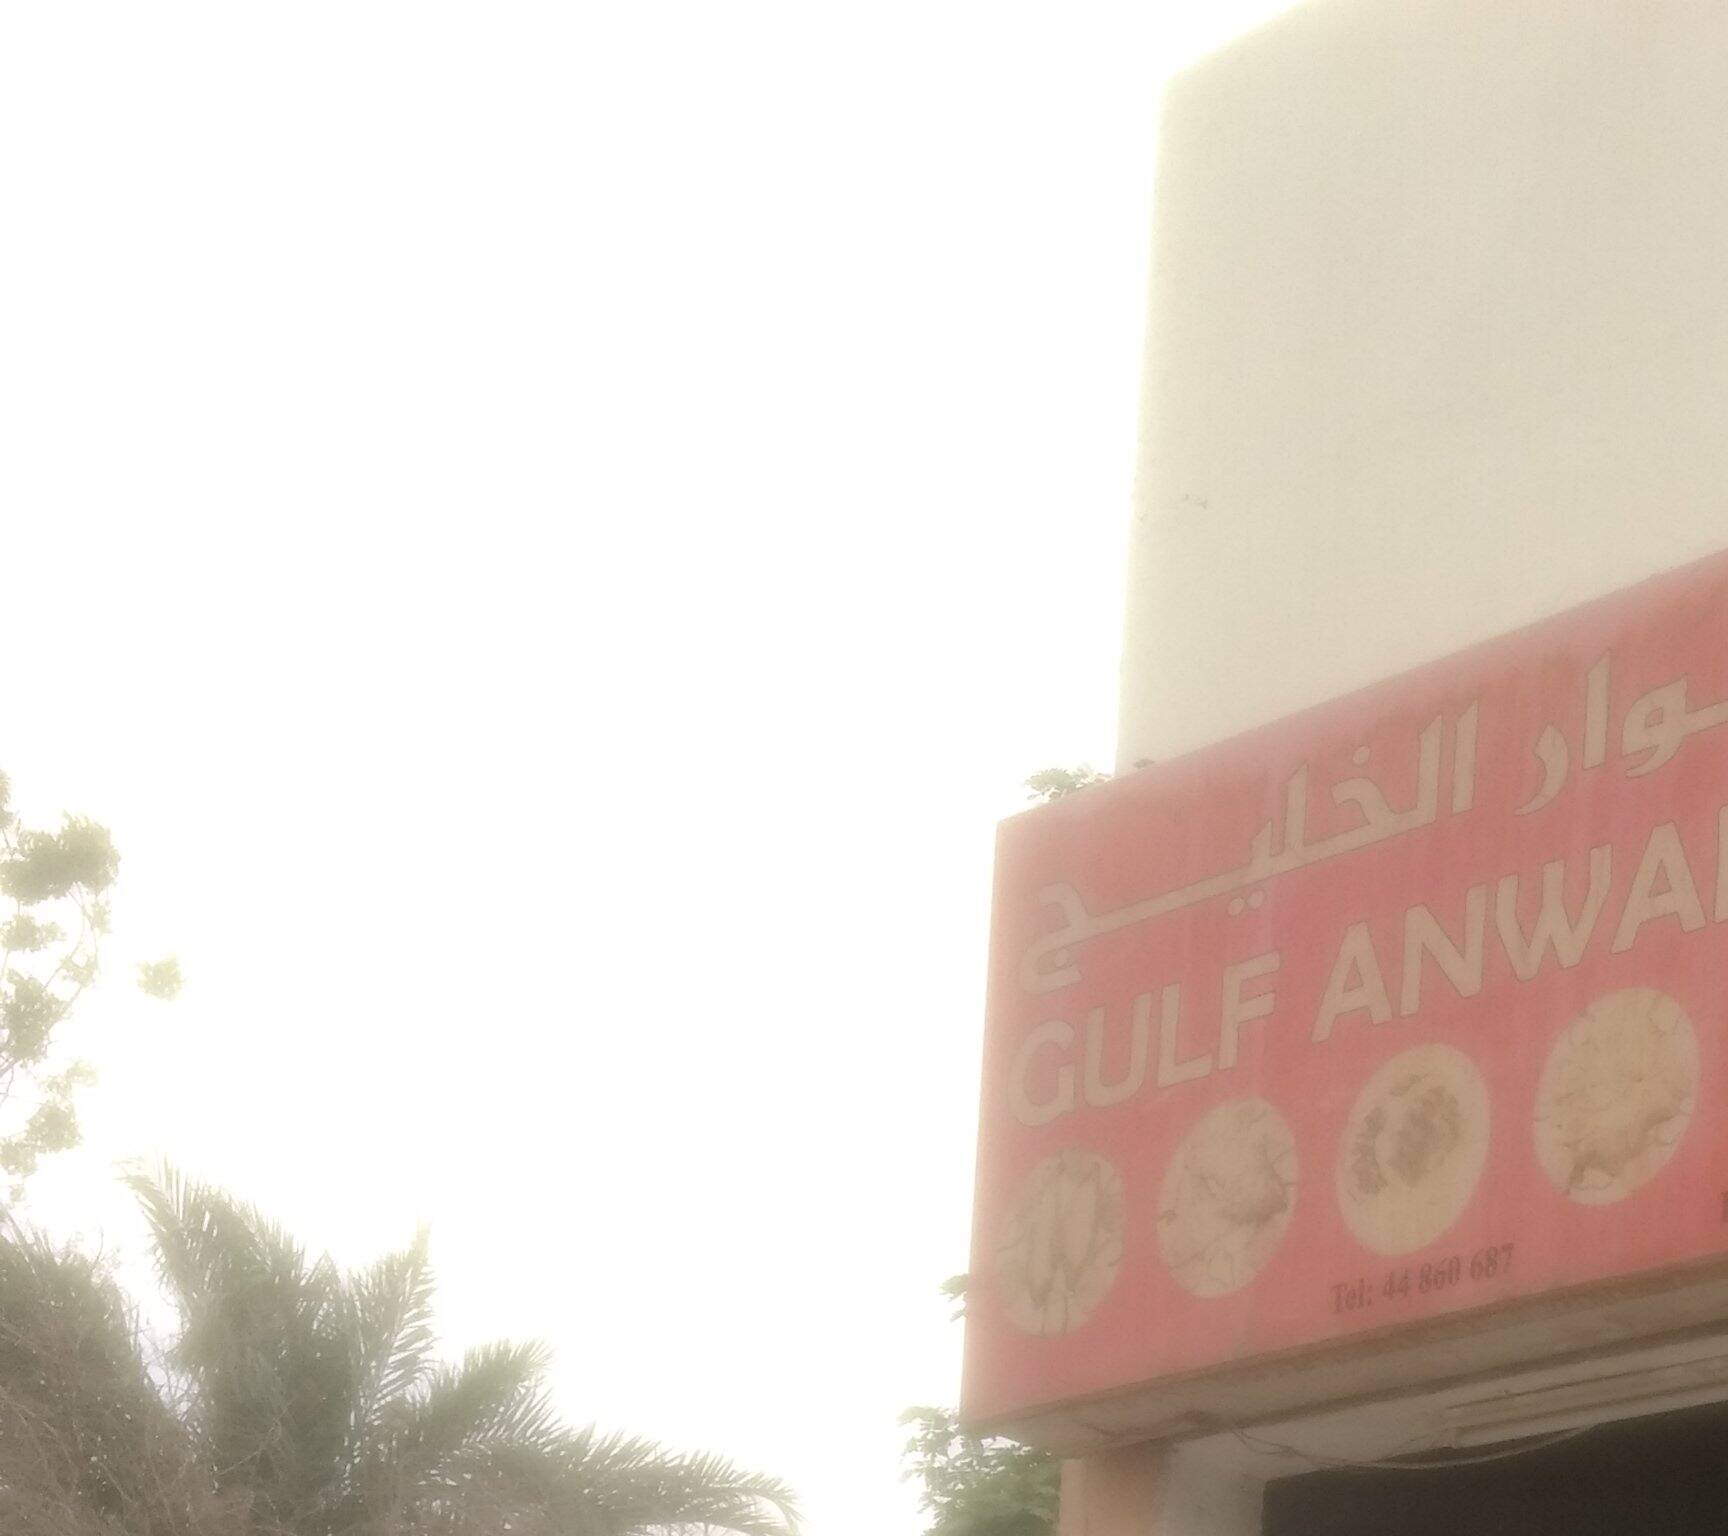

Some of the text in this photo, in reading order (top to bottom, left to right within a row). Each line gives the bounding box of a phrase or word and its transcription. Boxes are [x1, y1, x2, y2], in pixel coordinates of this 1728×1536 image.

[1016, 698, 1481, 999] الخليج
[1010, 950, 1283, 1130] GULF
[1331, 1242, 1515, 1315] Tel: 44 860 687
